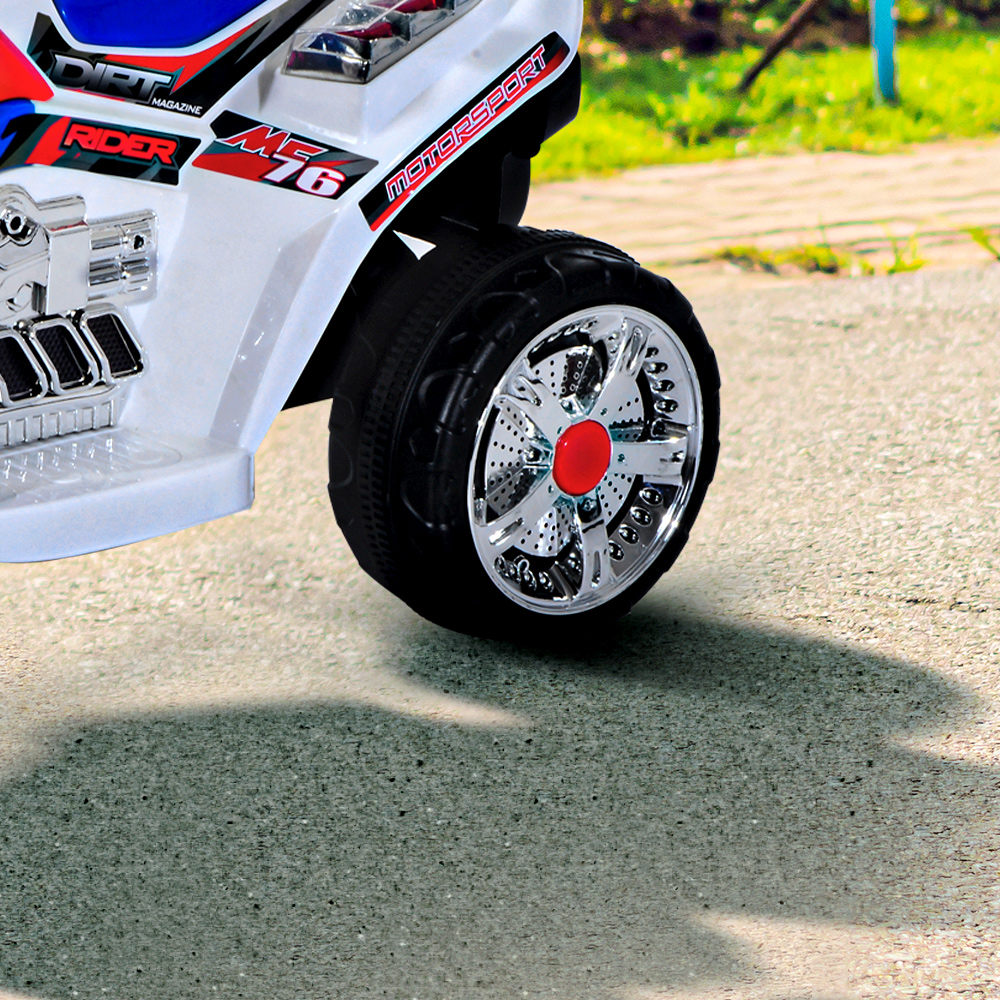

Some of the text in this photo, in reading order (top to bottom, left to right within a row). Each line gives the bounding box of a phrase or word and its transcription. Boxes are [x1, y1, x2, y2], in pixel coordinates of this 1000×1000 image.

[51, 52, 172, 104] DIRT
[151, 97, 203, 115] MAGAZINE
[385, 44, 547, 201] MOTORSPORT
[63, 123, 178, 166] RIDER
[216, 125, 329, 161] MF
[260, 153, 347, 198] 76
